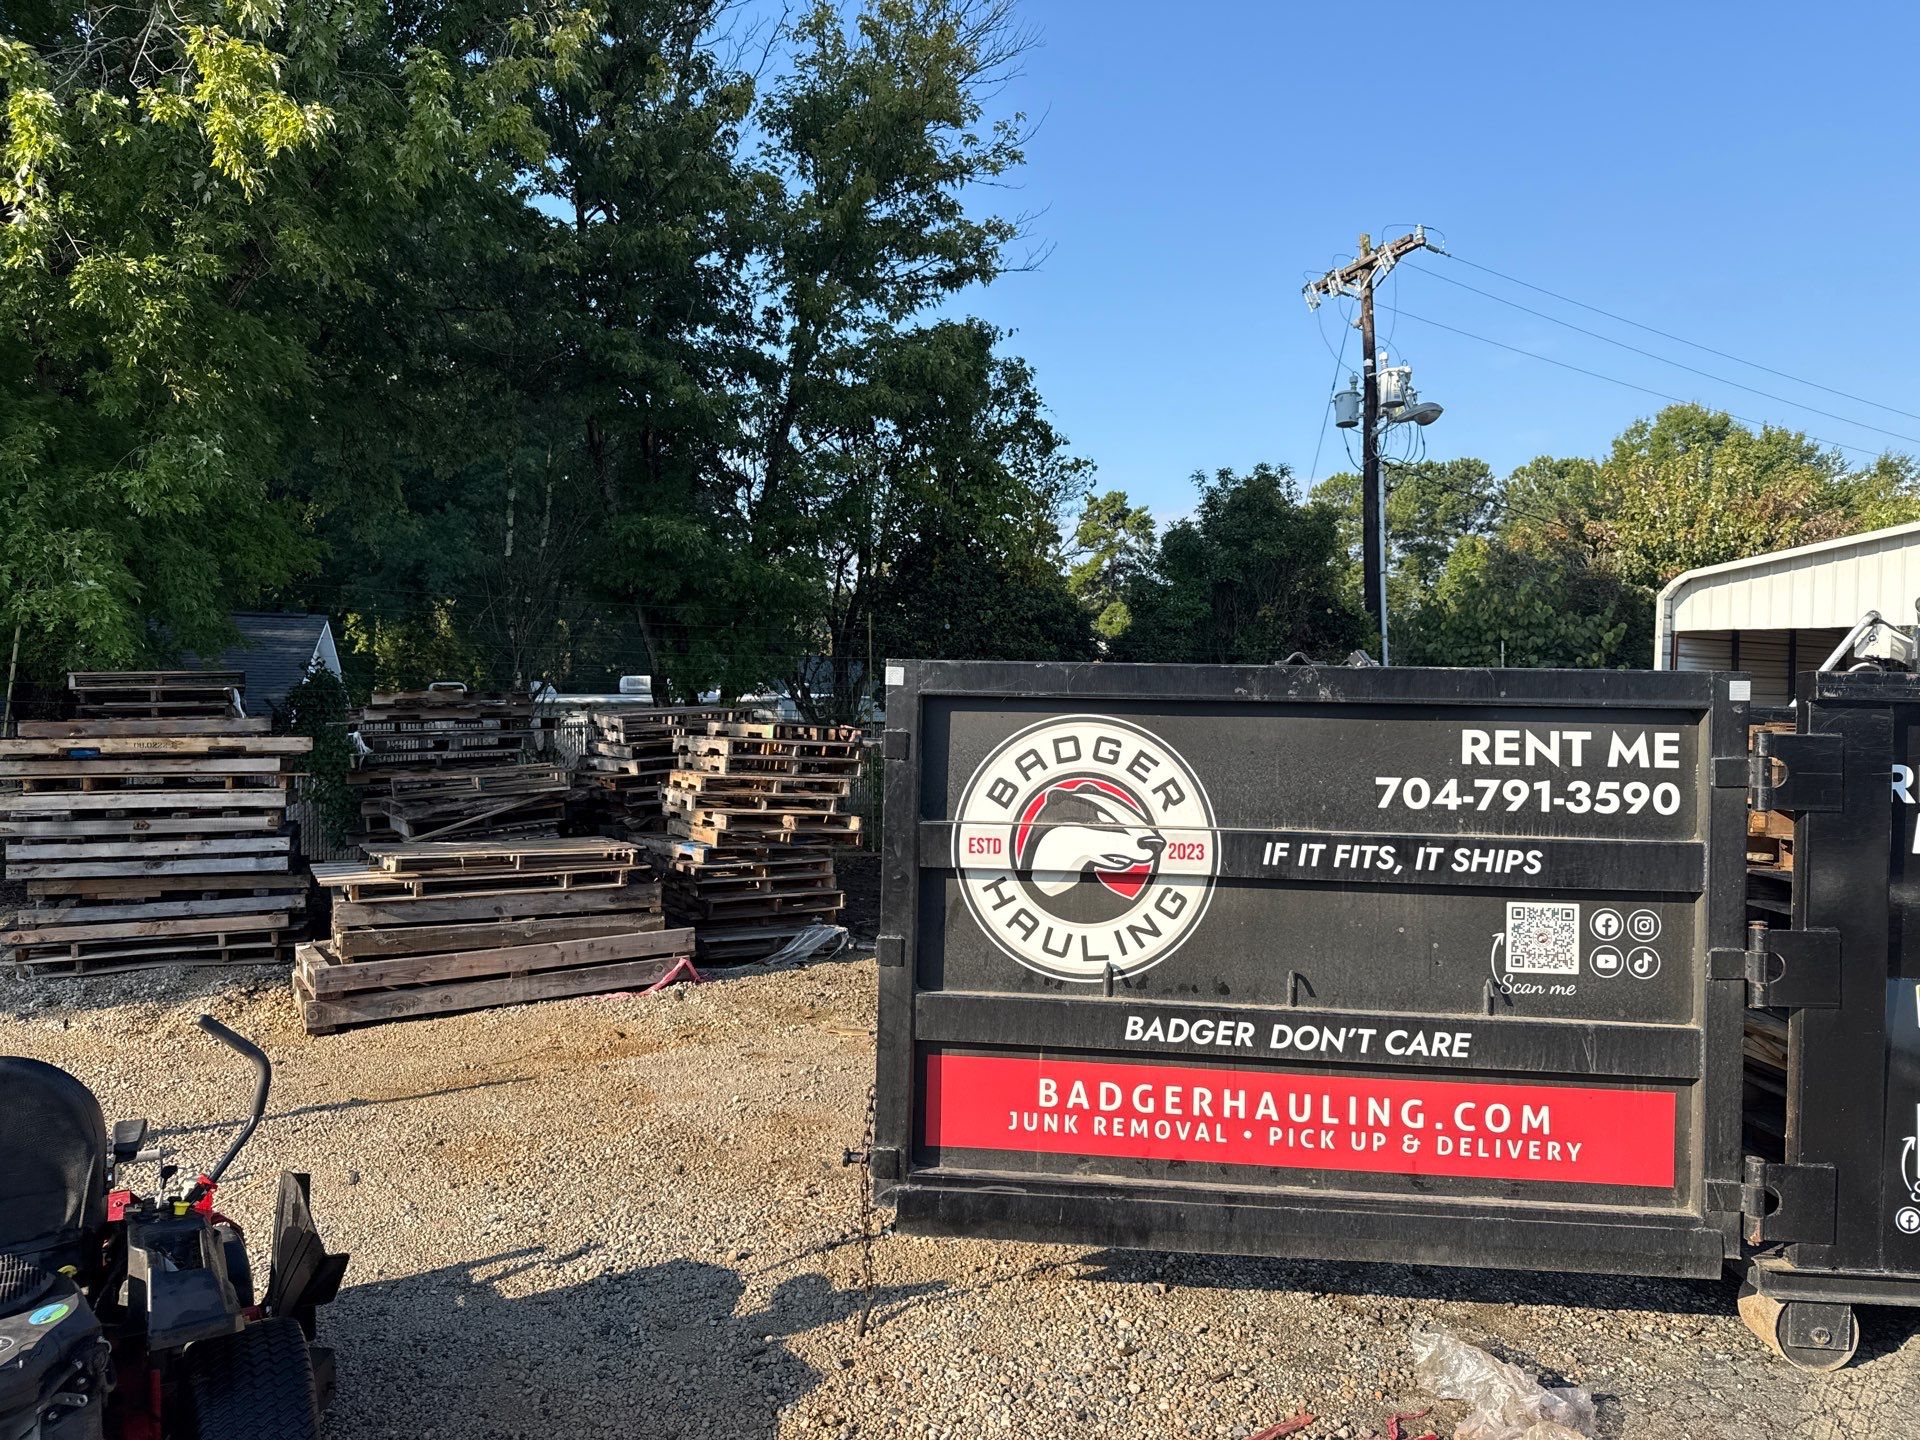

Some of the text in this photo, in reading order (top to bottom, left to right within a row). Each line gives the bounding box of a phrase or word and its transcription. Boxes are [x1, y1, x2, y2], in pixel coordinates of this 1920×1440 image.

[1461, 728, 1680, 769] RENT ME
[985, 734, 1187, 812] BADGER
[1375, 776, 1681, 816] 704-791-3590
[968, 837, 1002, 855] ESTD
[1168, 842, 1205, 861] 2023
[1262, 841, 1544, 875] IF IT FITS, IT SHIPS
[982, 875, 1188, 963] HAULING
[1500, 973, 1577, 996] Scan me
[1124, 1015, 1473, 1058] BADGER DON'T CARE
[1038, 1078, 1550, 1135] BADGERHAULING.COM
[1008, 1111, 1582, 1162] JUNK REMOVAL PICK UP & DELIVERY
